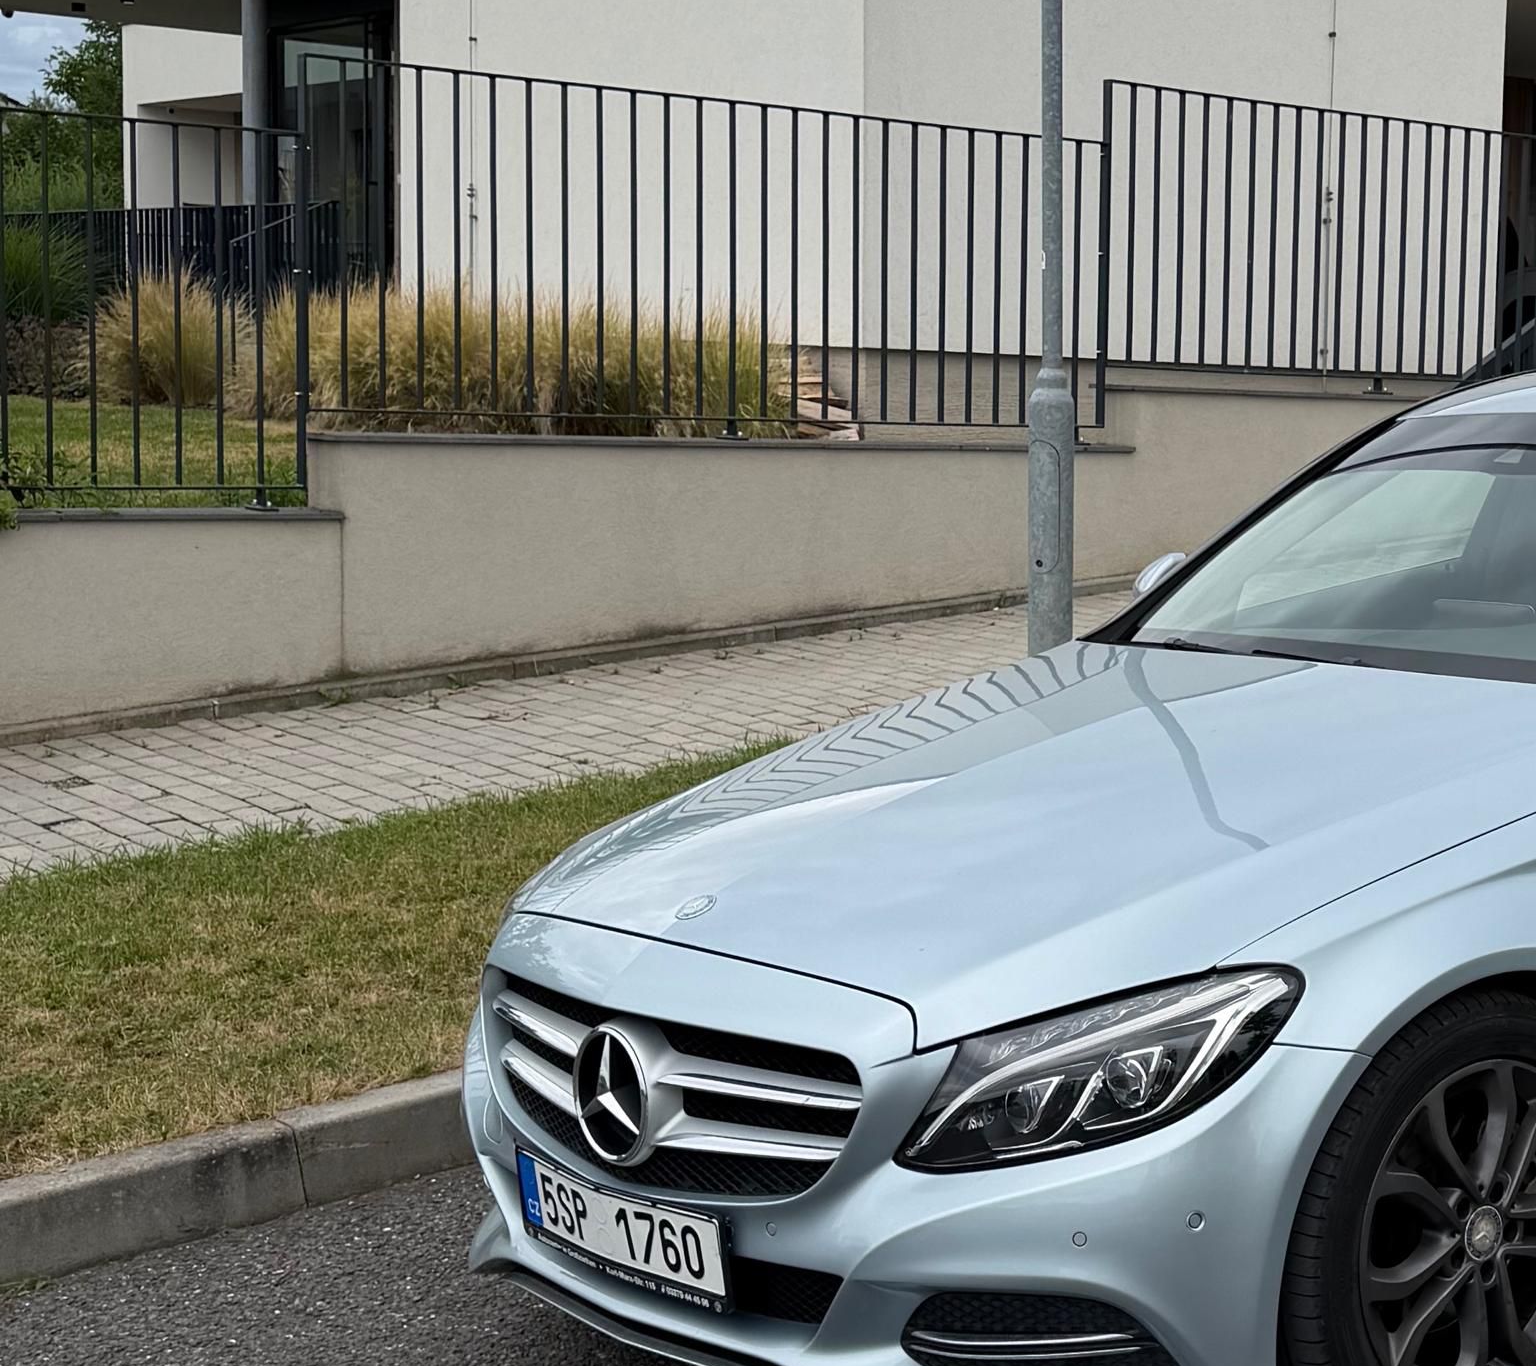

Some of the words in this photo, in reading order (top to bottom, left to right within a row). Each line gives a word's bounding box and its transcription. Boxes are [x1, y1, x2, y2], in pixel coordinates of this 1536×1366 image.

[528, 1198, 541, 1216] CZ
[540, 1171, 588, 1241] 5SP
[614, 1207, 705, 1280] 1760
